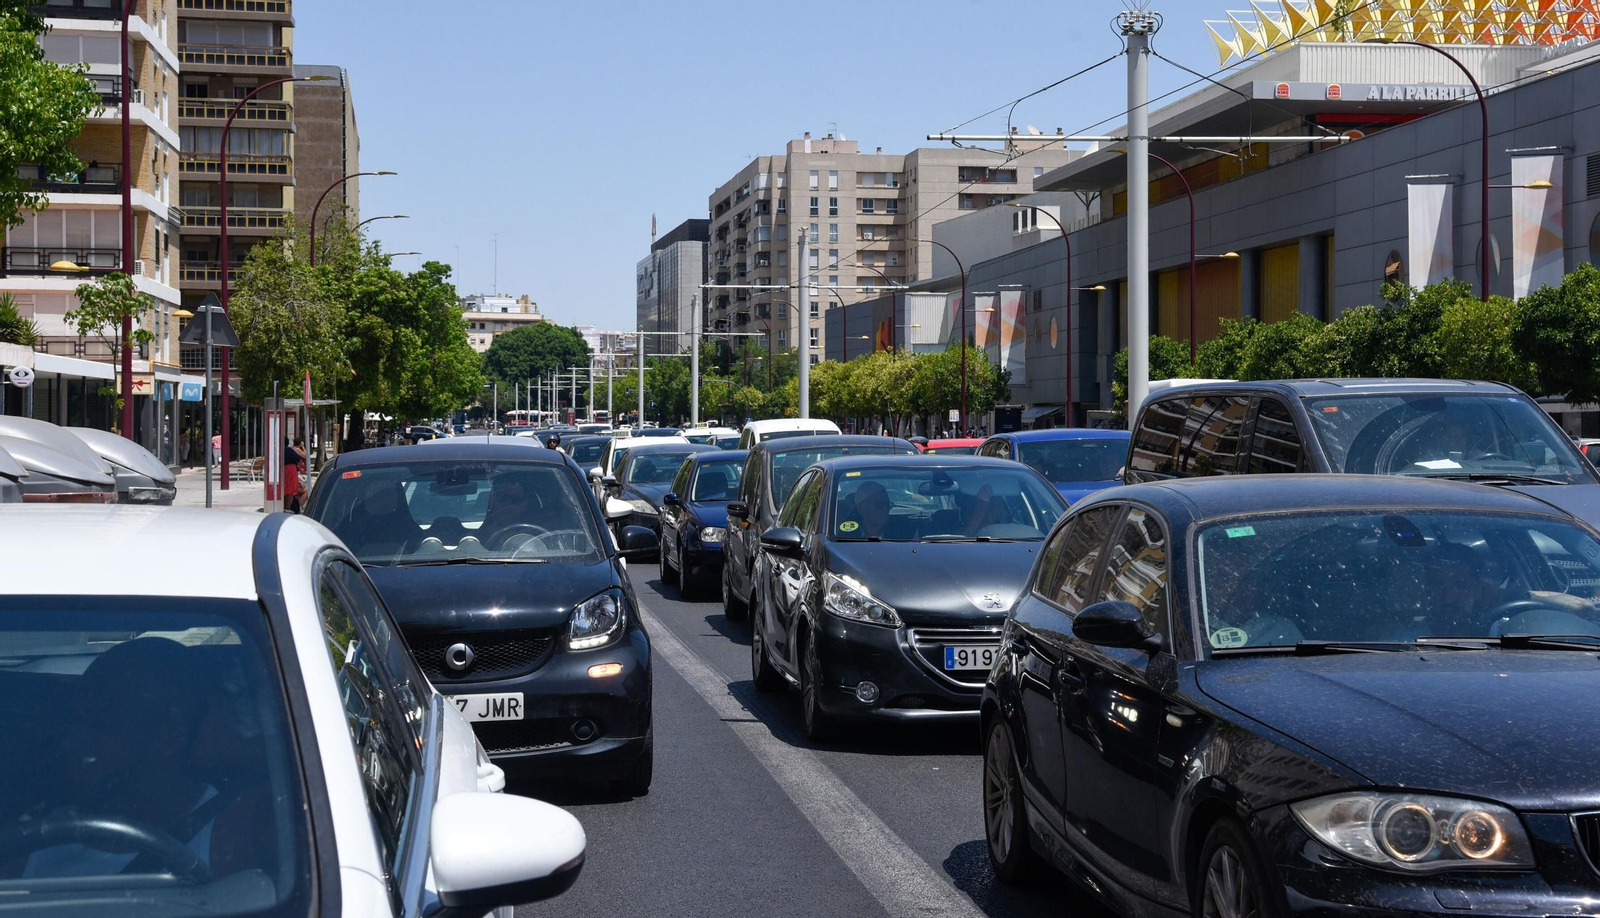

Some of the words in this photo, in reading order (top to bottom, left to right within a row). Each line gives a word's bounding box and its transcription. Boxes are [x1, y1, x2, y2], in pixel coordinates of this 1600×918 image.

[1367, 85, 1380, 100] A
[1382, 85, 1404, 101] LA
[478, 698, 519, 718] JMR
